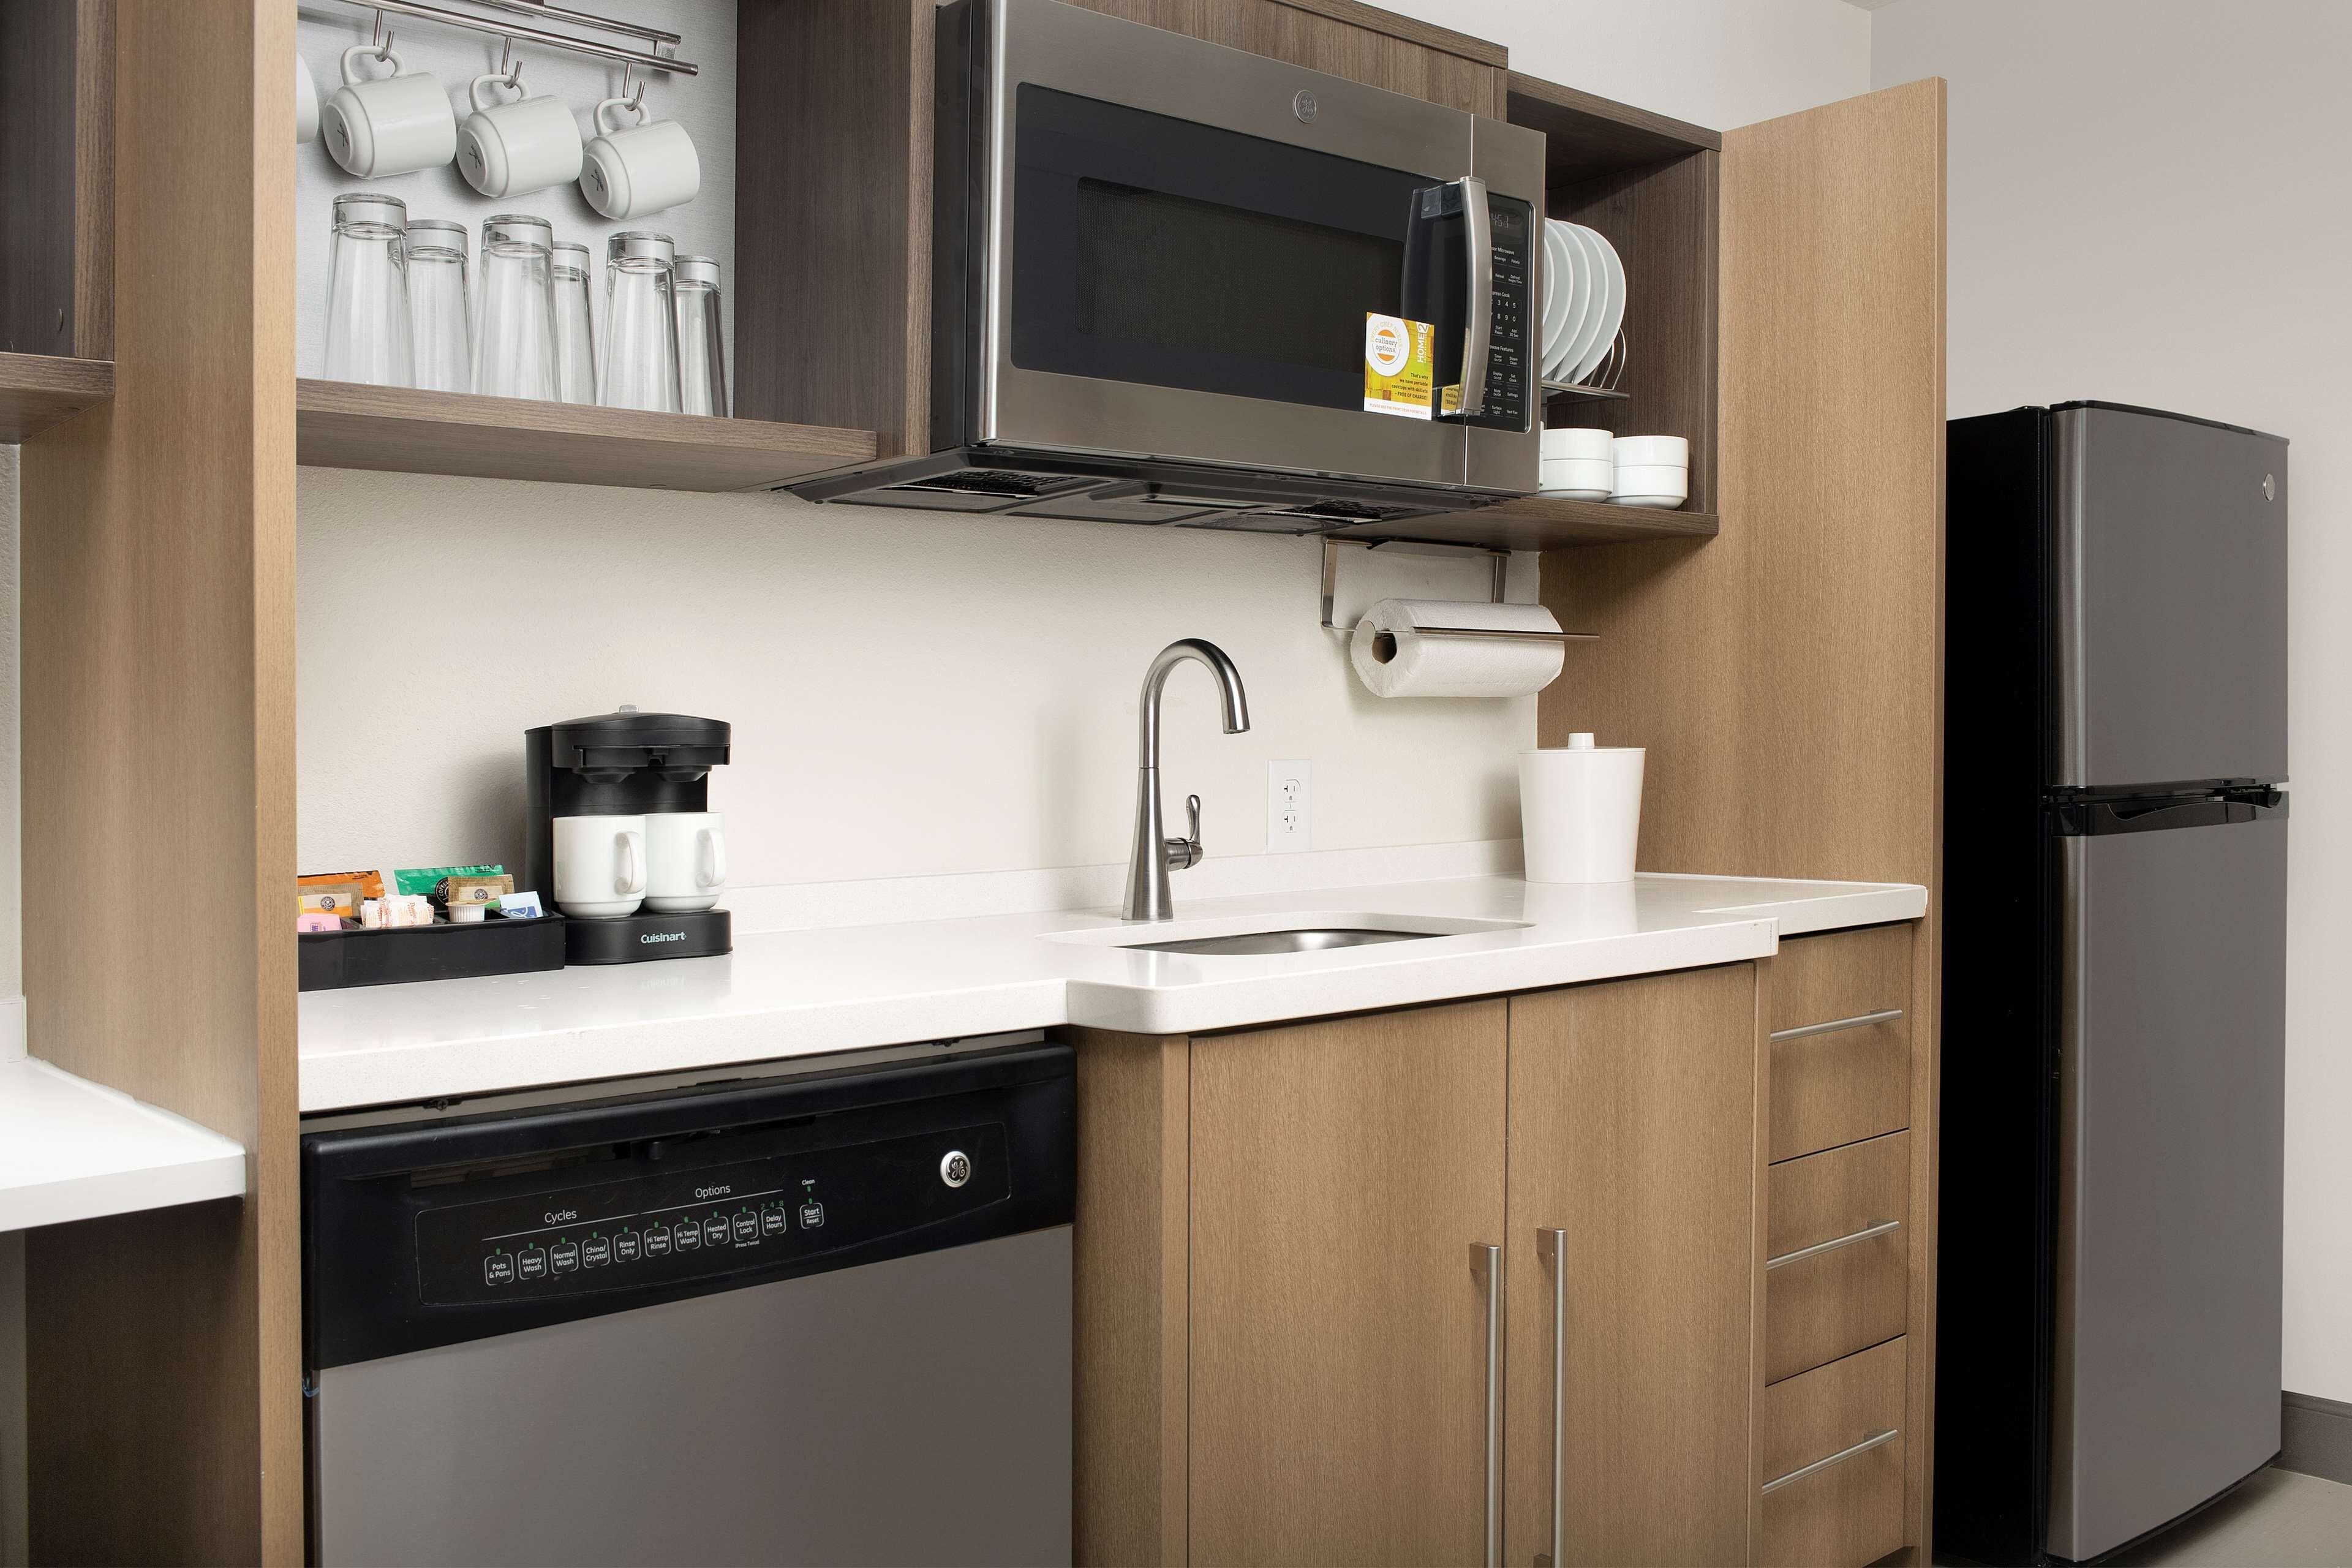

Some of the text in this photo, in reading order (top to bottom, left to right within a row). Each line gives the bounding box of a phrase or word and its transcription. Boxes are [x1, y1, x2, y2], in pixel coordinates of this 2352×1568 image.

[1375, 337, 1398, 347] culinary
[641, 932, 685, 944] Cuisinart
[695, 1184, 731, 1199] Options
[804, 1207, 820, 1216] Start
[545, 1209, 578, 1224] Cycles
[766, 1214, 782, 1223] Delay
[736, 1218, 755, 1227] Control
[766, 1221, 783, 1229] Hours
[707, 1224, 726, 1233] Heated
[683, 1229, 698, 1238] Temp
[712, 1231, 723, 1240] Dry
[654, 1234, 669, 1244] Temp
[680, 1235, 696, 1244] Wash
[586, 1244, 606, 1254] China/
[619, 1240, 635, 1249] Rinse
[650, 1242, 666, 1250] Rinse
[554, 1250, 576, 1261] Normal
[620, 1247, 635, 1256] Only
[522, 1256, 542, 1266] Heavy
[586, 1251, 608, 1262] Crystal
[556, 1258, 575, 1267] Wash
[524, 1263, 542, 1272] Wash
[495, 1269, 511, 1278] Pans
